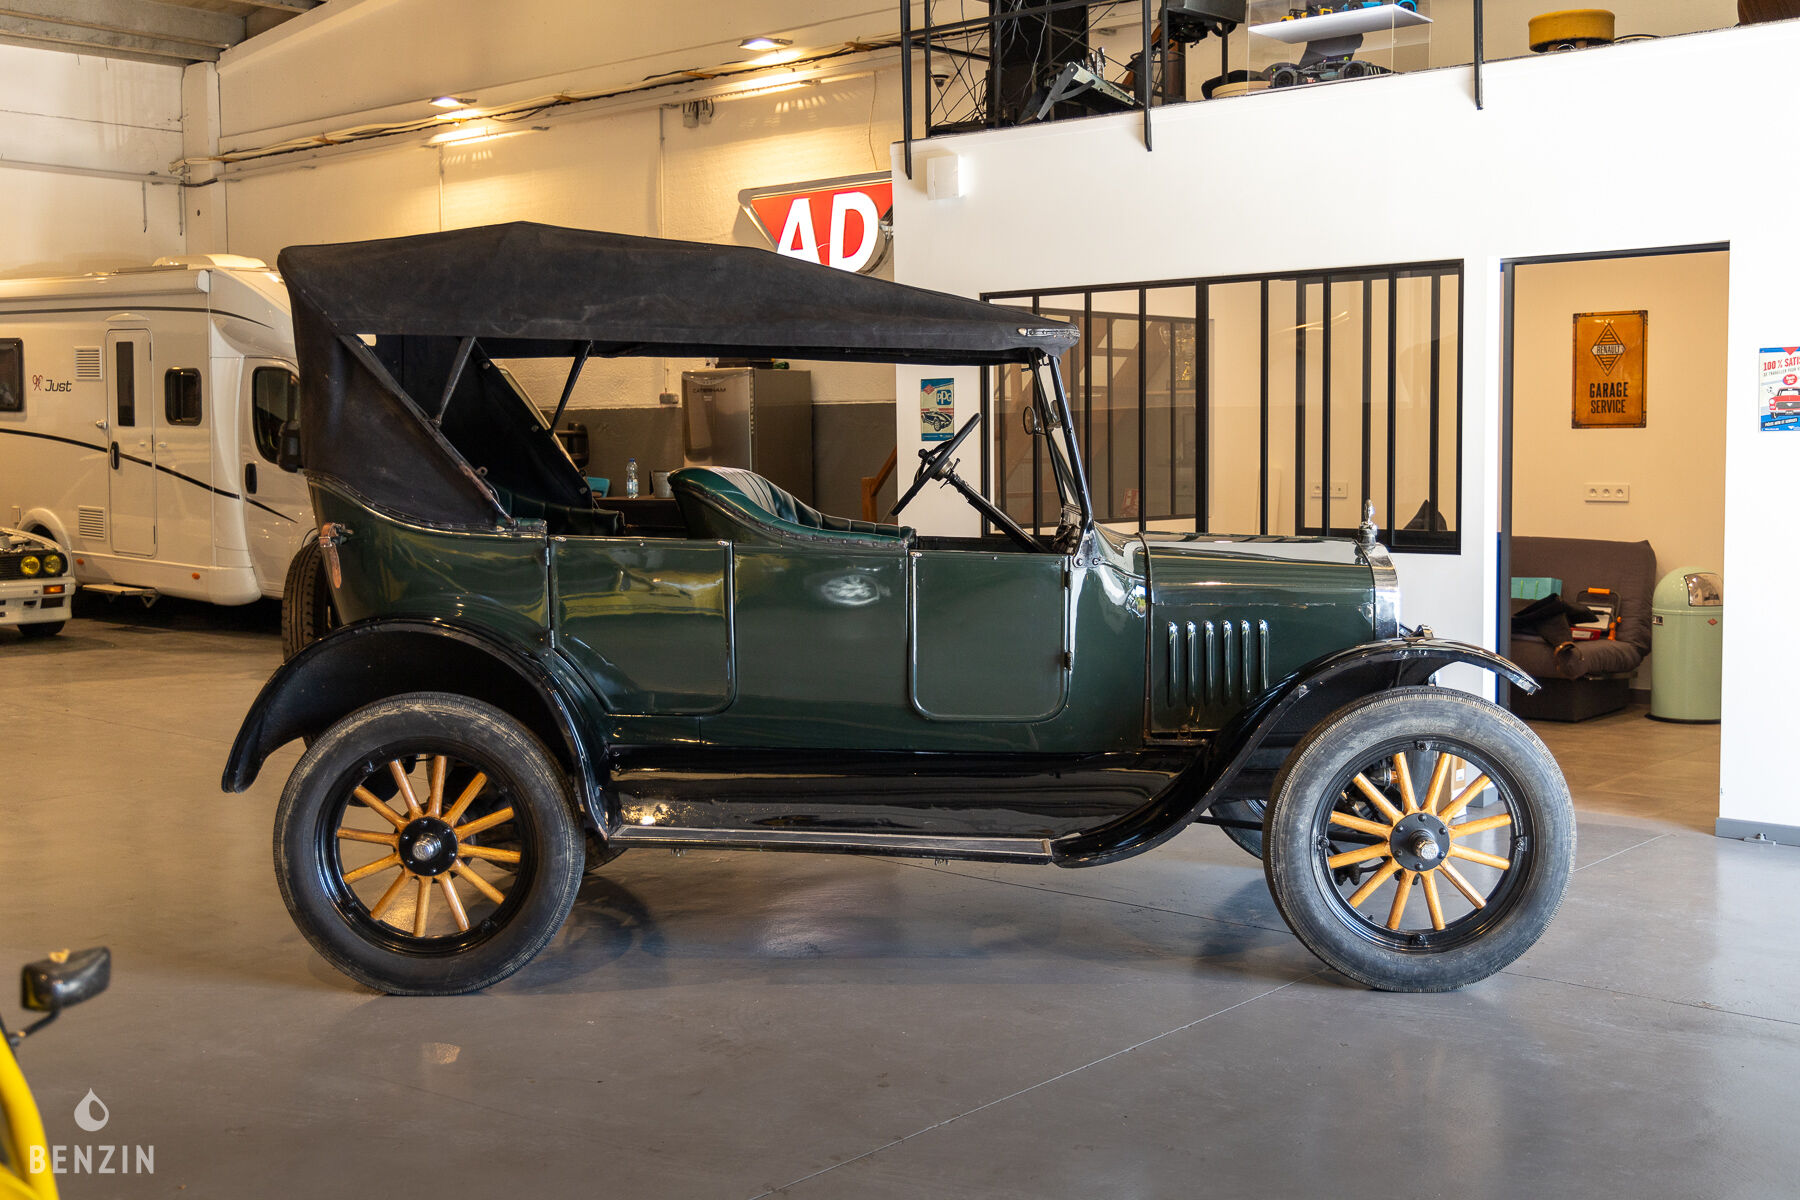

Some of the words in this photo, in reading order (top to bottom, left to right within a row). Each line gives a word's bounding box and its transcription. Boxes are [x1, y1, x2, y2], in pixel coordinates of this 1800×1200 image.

[777, 191, 879, 273] AD
[1596, 346, 1620, 354] RENAULT
[1763, 360, 1776, 371] 100
[45, 379, 73, 392] Just
[1589, 381, 1629, 398] GARAGE
[936, 391, 952, 404] PPG
[1590, 399, 1626, 414] SERVICE
